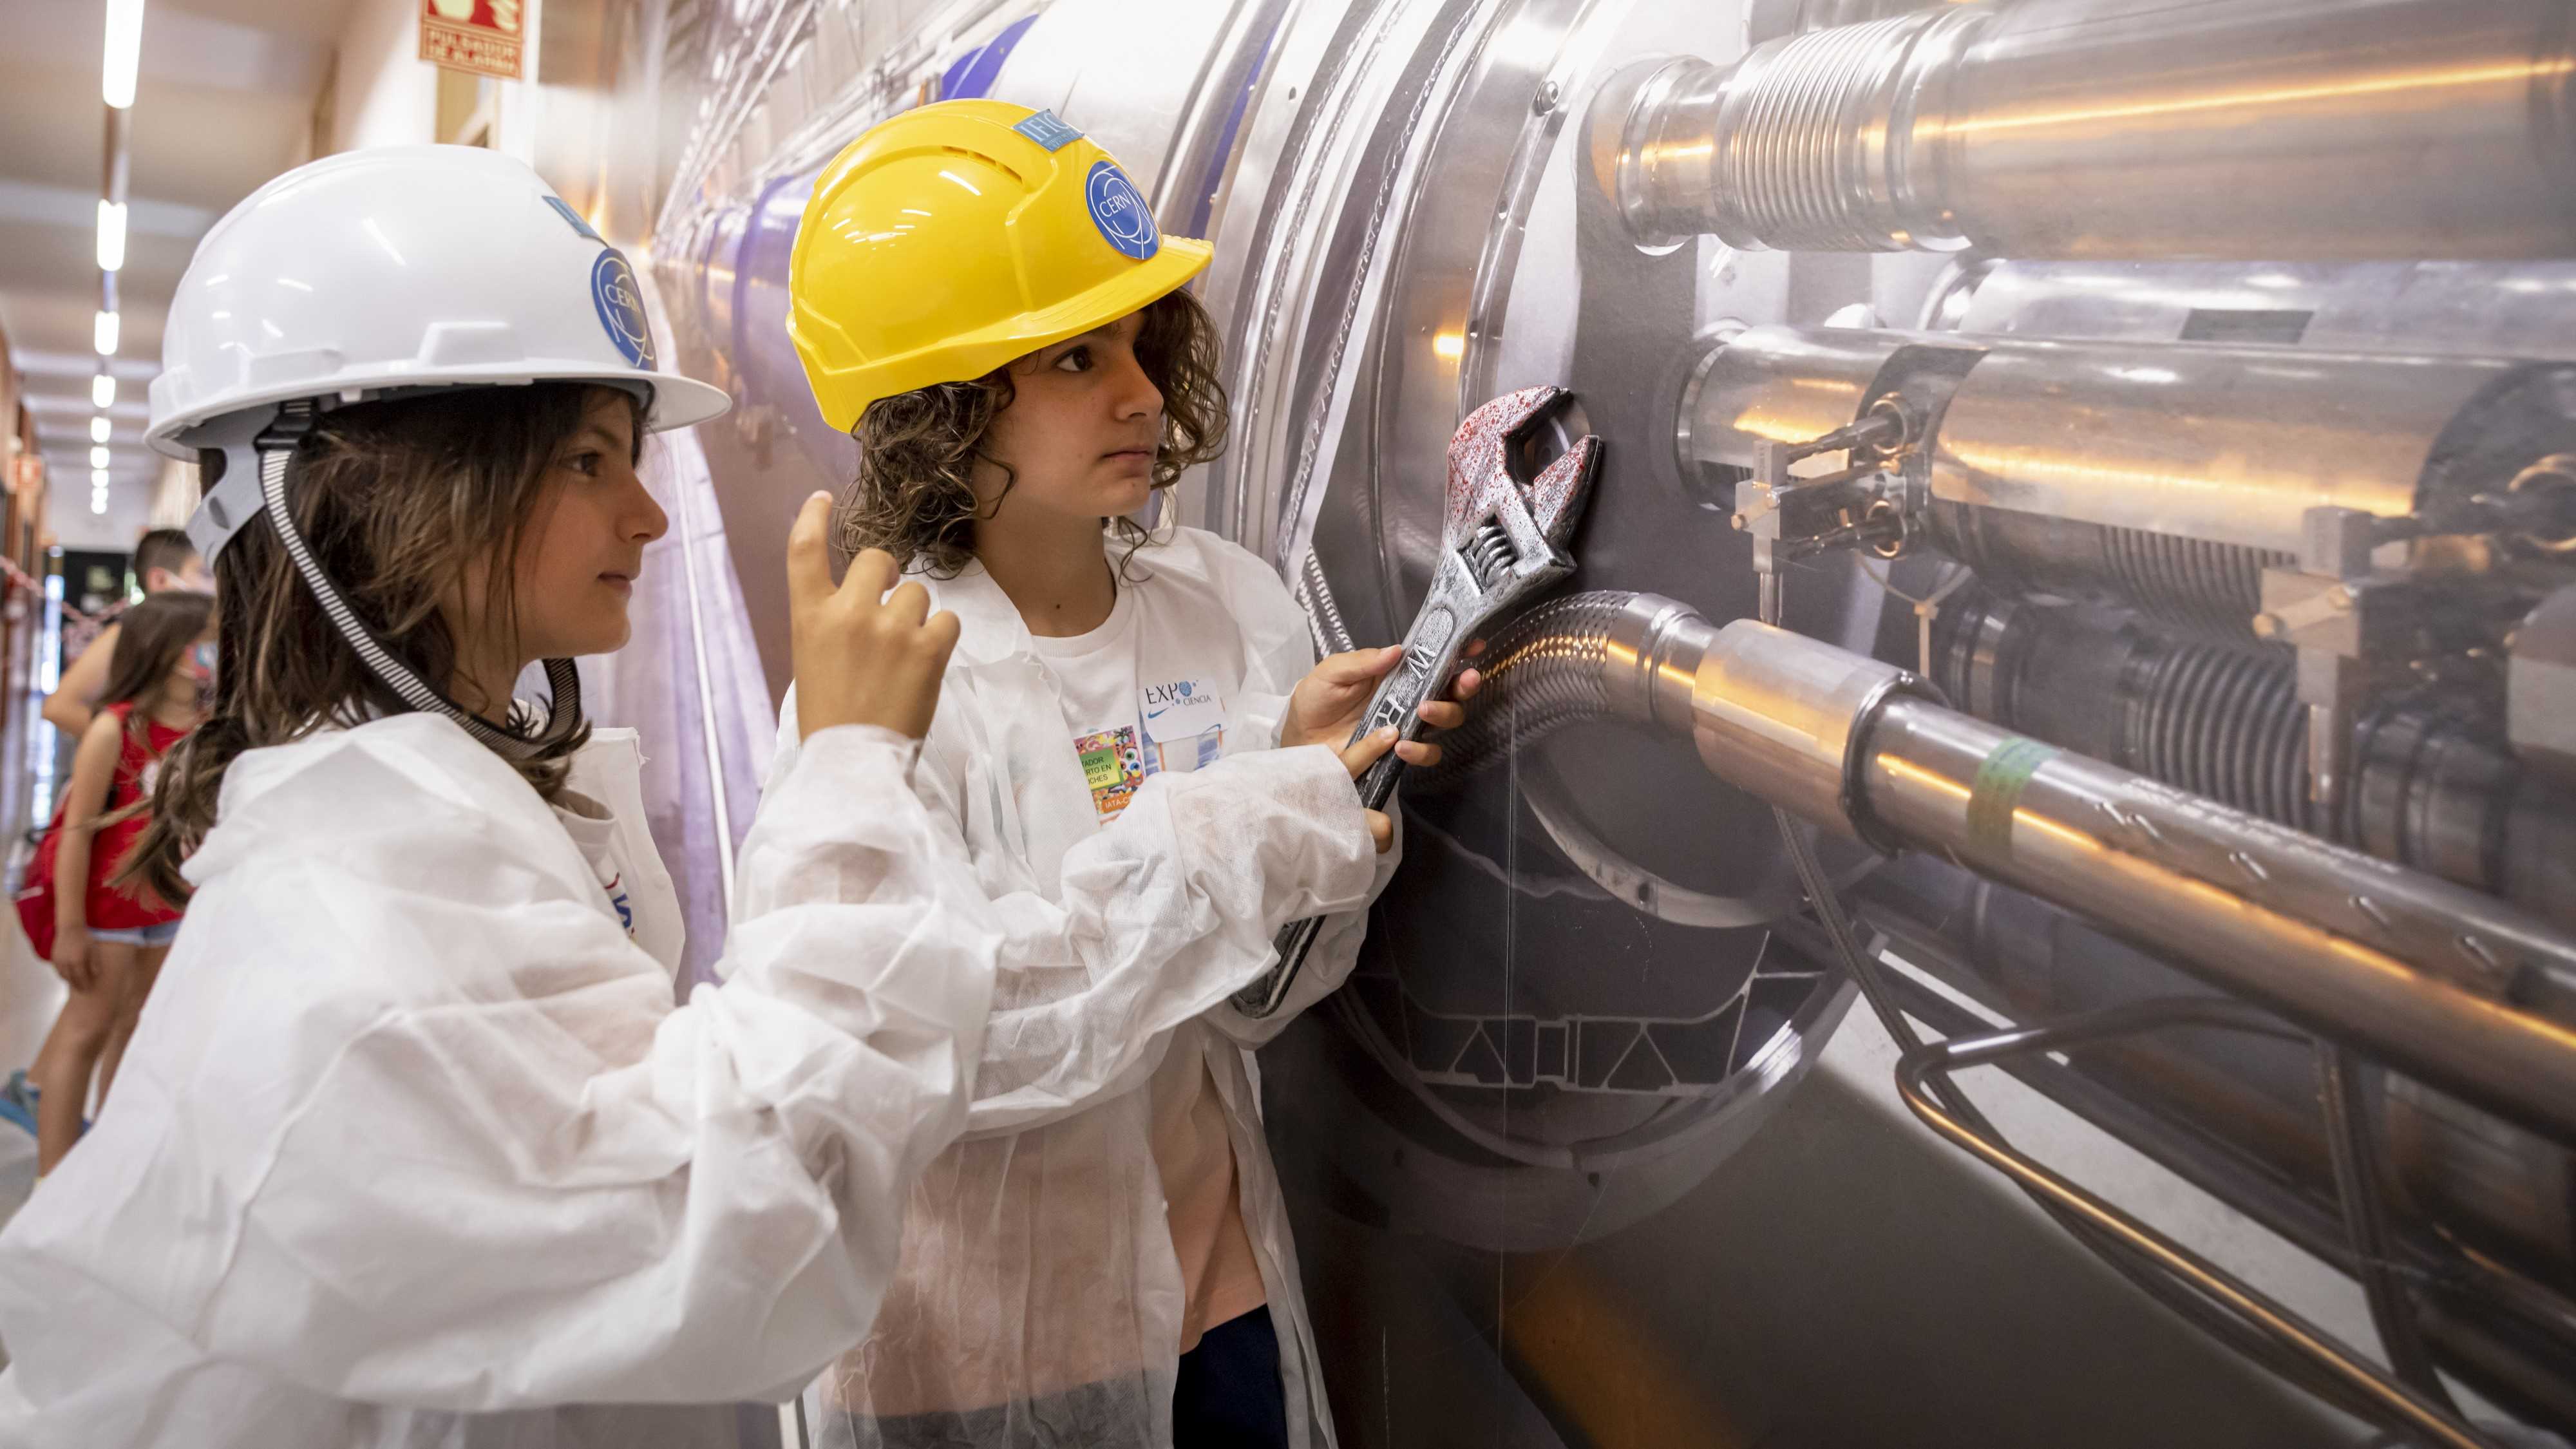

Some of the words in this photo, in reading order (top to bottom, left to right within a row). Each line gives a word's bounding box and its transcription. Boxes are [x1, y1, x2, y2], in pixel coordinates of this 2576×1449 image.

[1019, 112, 1070, 142] IFIC
[1099, 192, 1132, 218] CERN
[605, 283, 641, 315] CERN
[1183, 695, 1212, 706] CIENCIA
[1086, 767, 1100, 776] RTO
